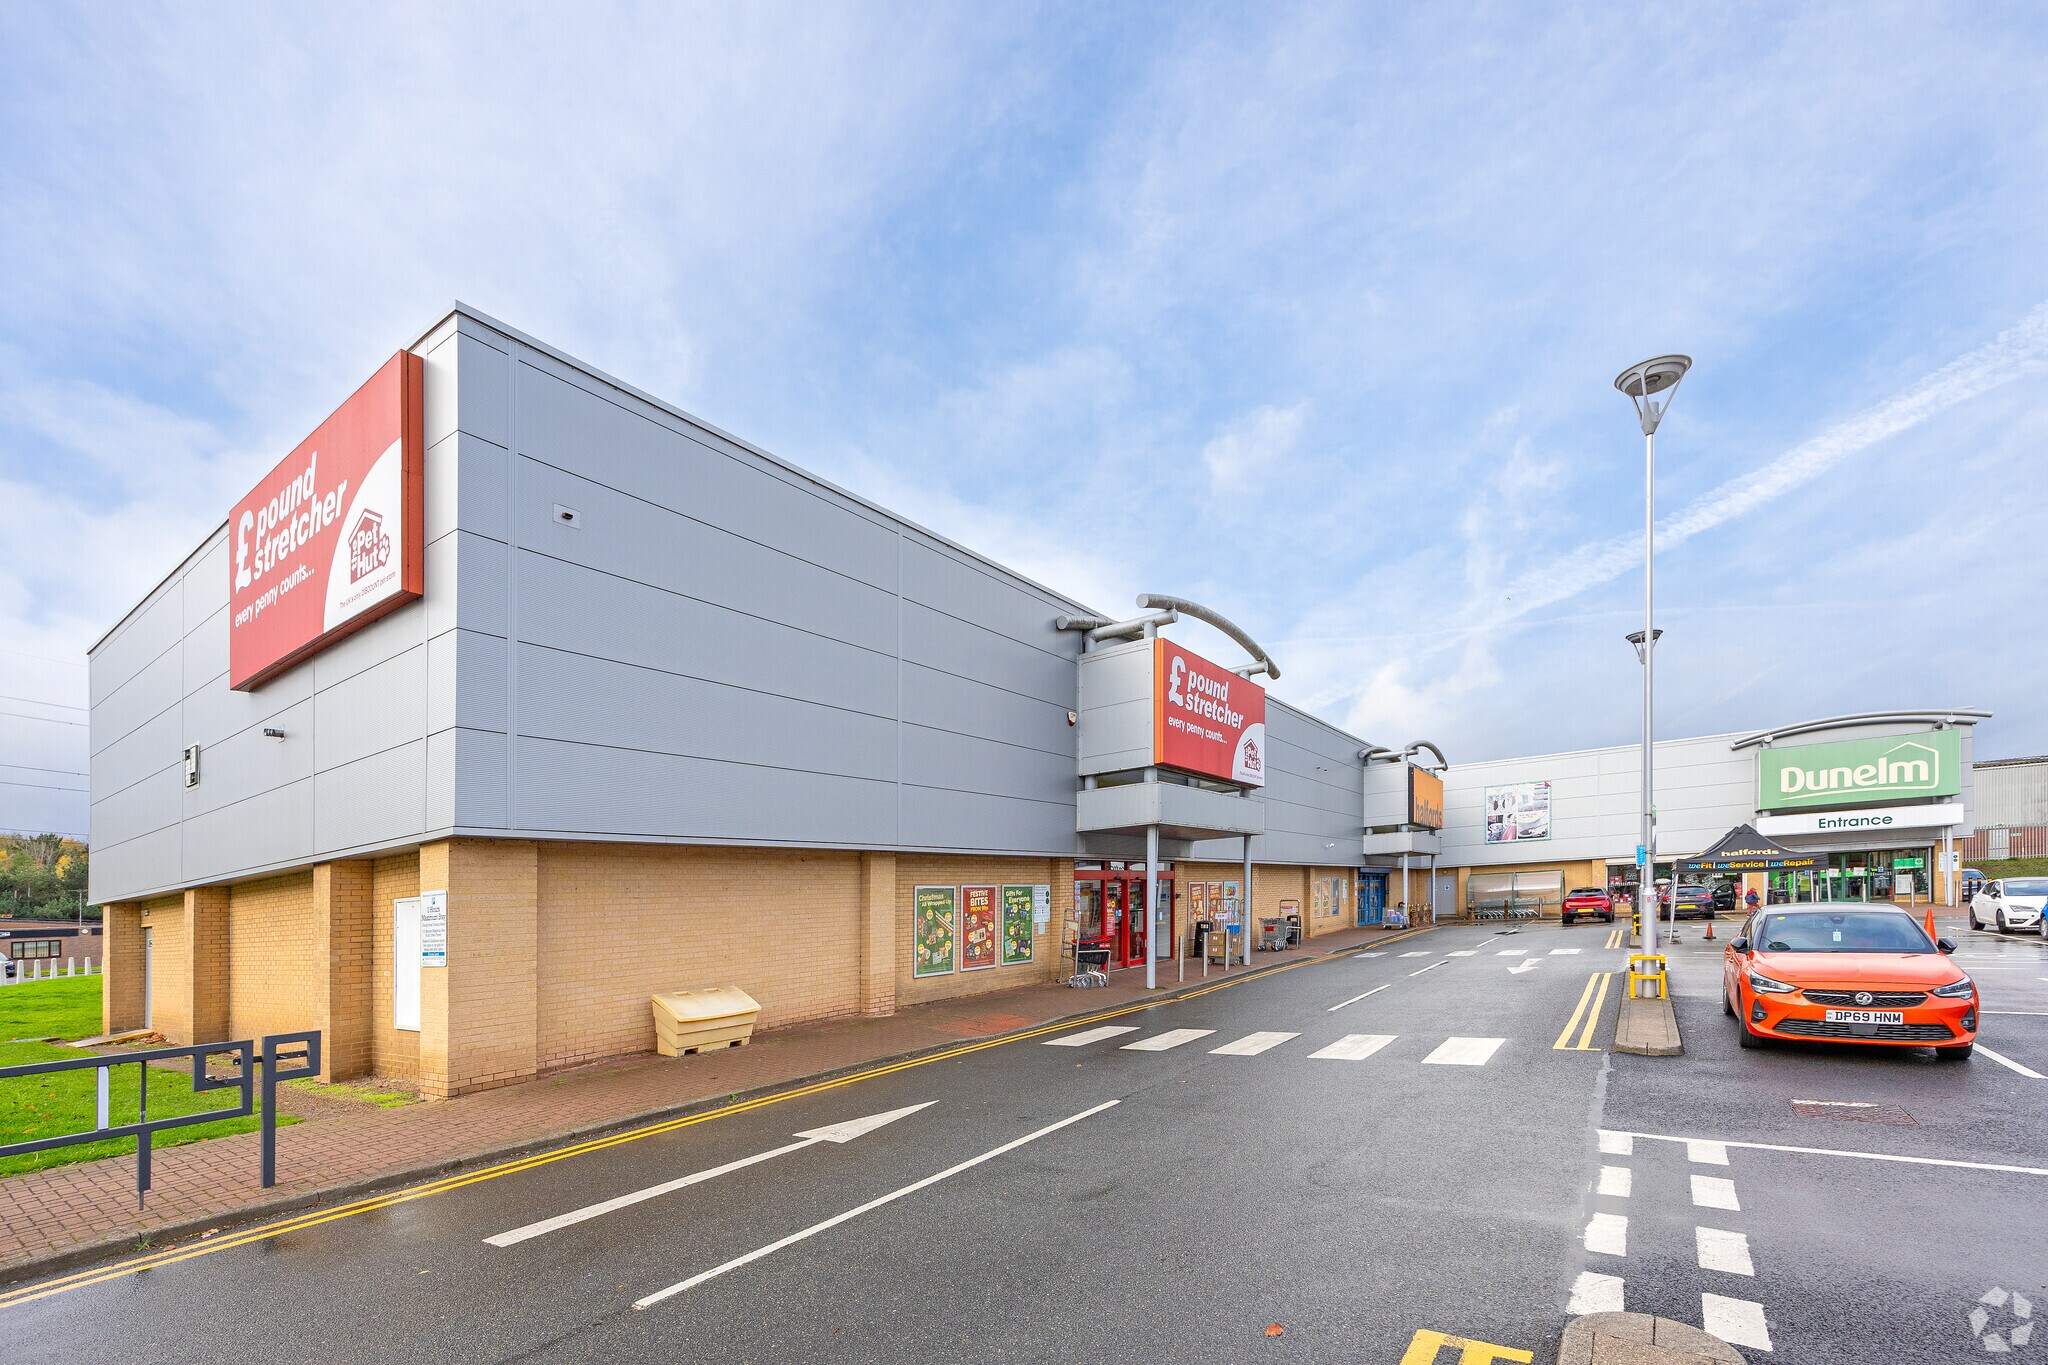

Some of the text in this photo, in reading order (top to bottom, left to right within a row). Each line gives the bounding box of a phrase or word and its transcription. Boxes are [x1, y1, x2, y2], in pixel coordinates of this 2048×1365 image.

[255, 450, 318, 552] pound
[253, 479, 348, 582] stretcher
[357, 521, 379, 553] Pet
[356, 545, 379, 579] Hut
[234, 602, 254, 628] every
[255, 585, 279, 619] penny
[1187, 669, 1230, 702] pound
[1185, 691, 1244, 730] stretcher
[1168, 716, 1186, 733] every
[1186, 722, 1205, 740] penny
[1780, 756, 1929, 793] Dunelm
[1818, 814, 1893, 829] Entrance
[1717, 861, 1765, 869] weService
[1770, 858, 1815, 867] weRepair
[1721, 848, 1780, 857] halfords
[918, 893, 944, 901] Christmas
[970, 889, 988, 898] FESTIVE
[970, 897, 989, 906] BITES
[1008, 896, 1030, 904] Everyone
[1835, 1011, 1870, 1022] DP69
[1874, 1012, 1901, 1023] HNM
